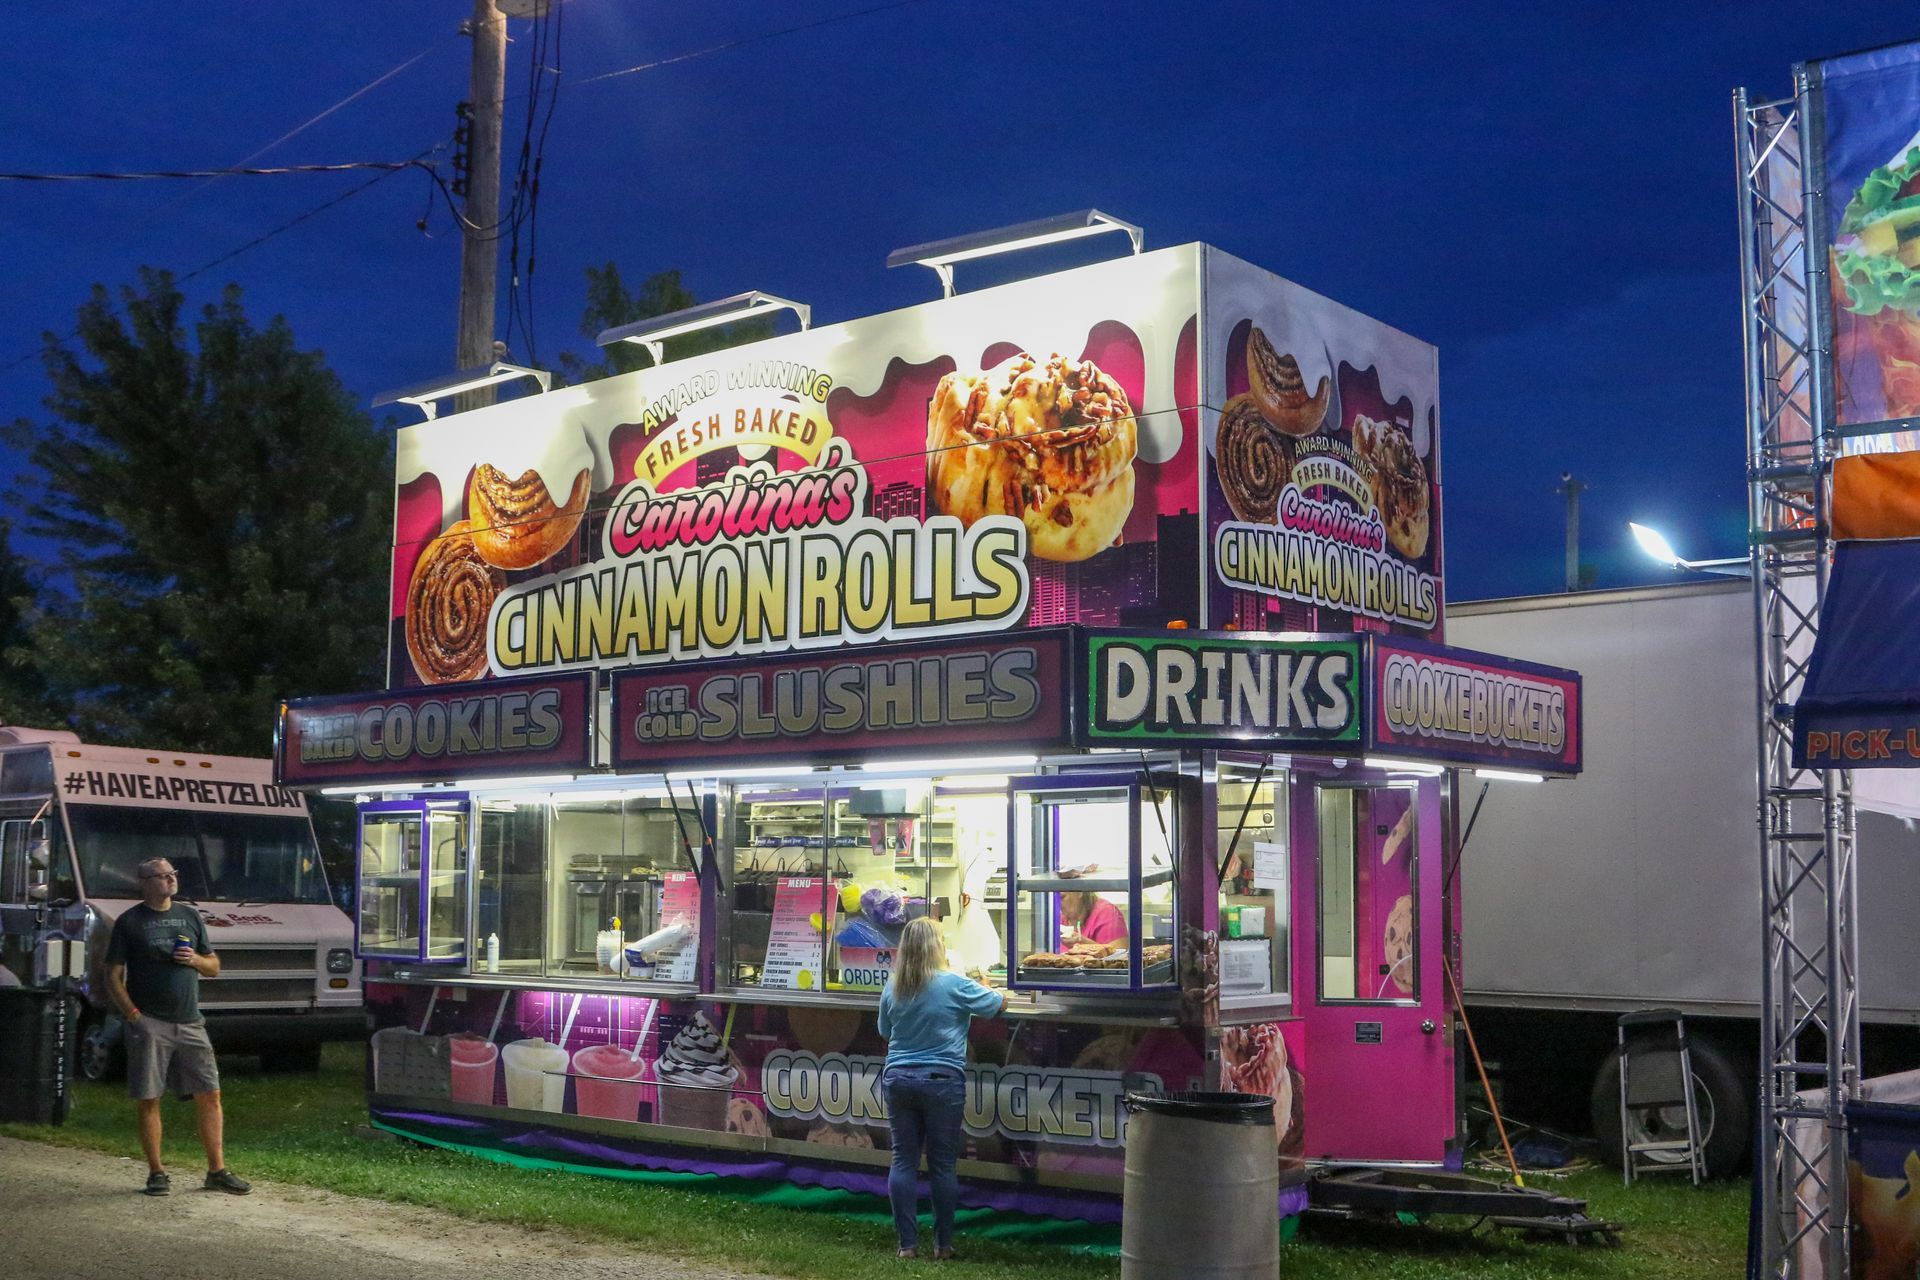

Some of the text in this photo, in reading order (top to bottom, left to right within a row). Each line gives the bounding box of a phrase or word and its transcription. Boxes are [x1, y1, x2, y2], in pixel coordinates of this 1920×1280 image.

[642, 360, 833, 437] AWARD WINNING
[644, 407, 819, 479] FRESH BAKED
[1295, 437, 1373, 483] AWARD WINNING
[608, 444, 858, 558] Carolina's
[1281, 487, 1384, 552] Carolina's
[1297, 464, 1369, 505] FRESH BAKED
[494, 524, 1022, 670] CINNAMON ROLLS
[1219, 528, 1437, 625] CINNAMON ROLLS
[648, 687, 688, 713] ICE
[700, 649, 1039, 741] SLUSHIES
[1105, 646, 1350, 730] DRINKS
[358, 689, 562, 760] COOKIES
[637, 712, 697, 740] COLD
[787, 879, 811, 889] MENU
[844, 968, 889, 986] ORDER
[766, 1056, 1161, 1140] COOK UCKET
